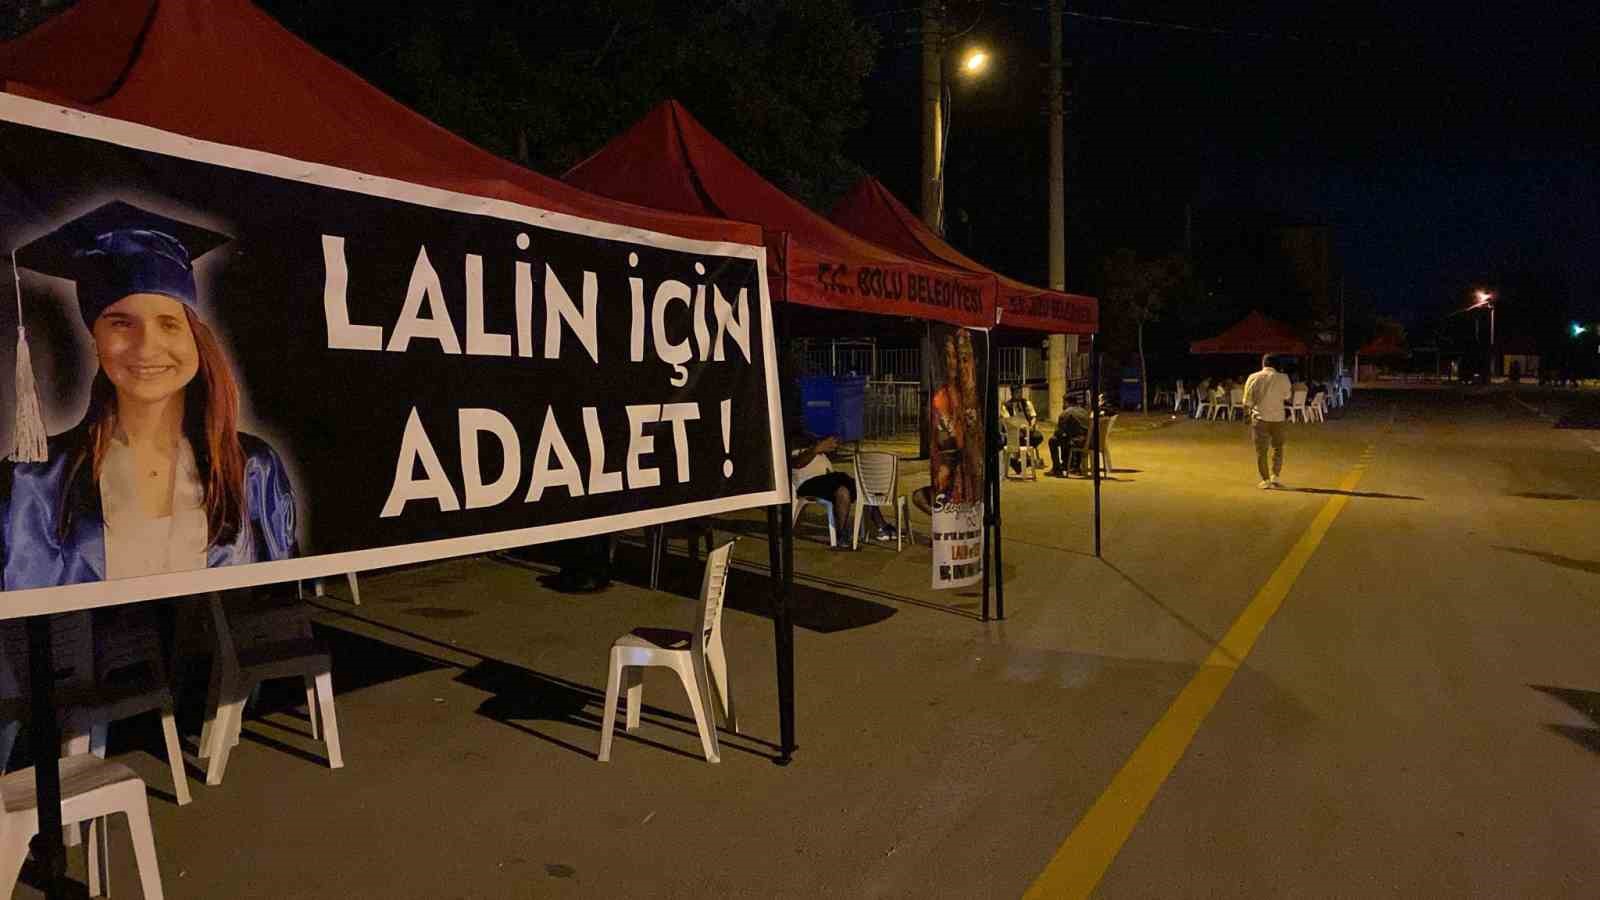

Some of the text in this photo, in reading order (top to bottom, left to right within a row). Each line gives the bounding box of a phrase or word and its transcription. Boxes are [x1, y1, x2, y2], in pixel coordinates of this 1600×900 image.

[322, 233, 751, 387] LALİN İÇİN
[857, 266, 903, 301] BOLU
[380, 404, 701, 518] ADALET
